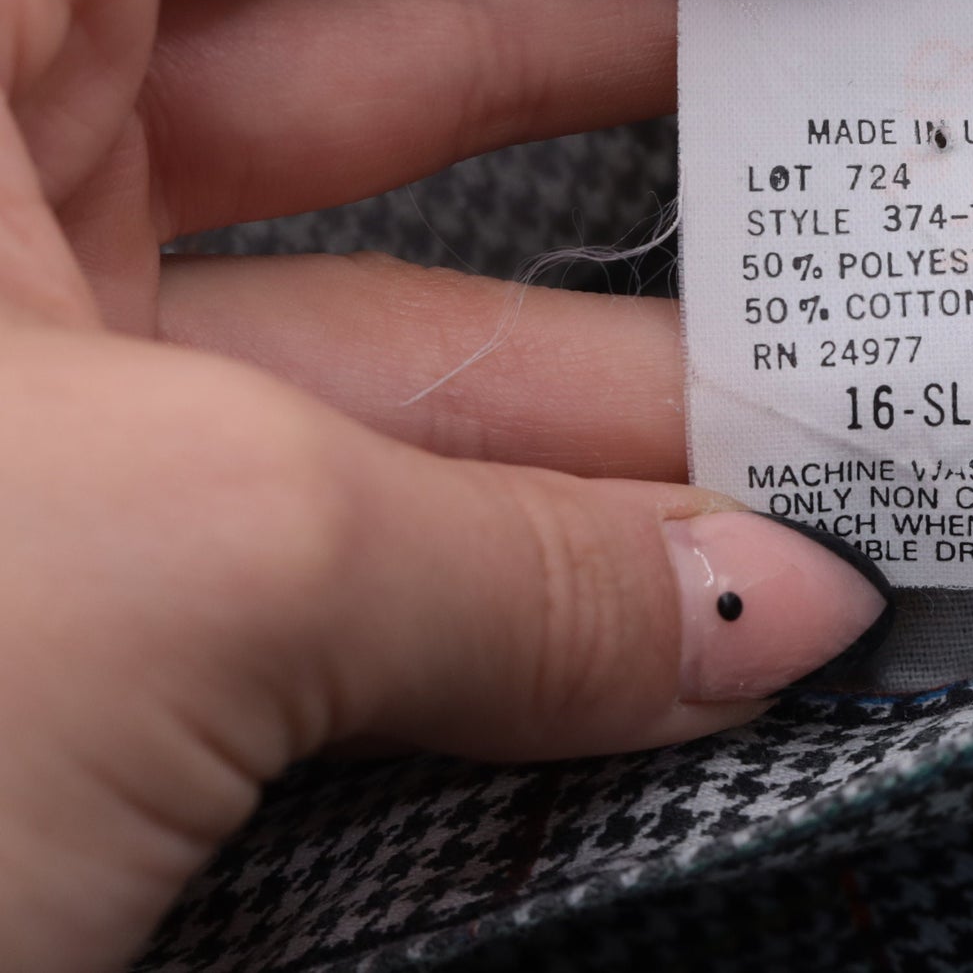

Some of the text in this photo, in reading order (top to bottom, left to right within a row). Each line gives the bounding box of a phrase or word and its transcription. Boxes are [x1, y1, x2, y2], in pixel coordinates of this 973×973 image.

[807, 118, 898, 146] MADE
[748, 162, 912, 193] LOT 724
[746, 208, 851, 237] STYLE
[753, 335, 923, 371] RN 24977
[845, 380, 972, 431] 16-SL
[747, 459, 895, 489] MACHINE
[769, 486, 852, 516] ONLY
[869, 485, 939, 510] NON
[799, 512, 877, 539] ACH
[852, 538, 919, 563] BLE
